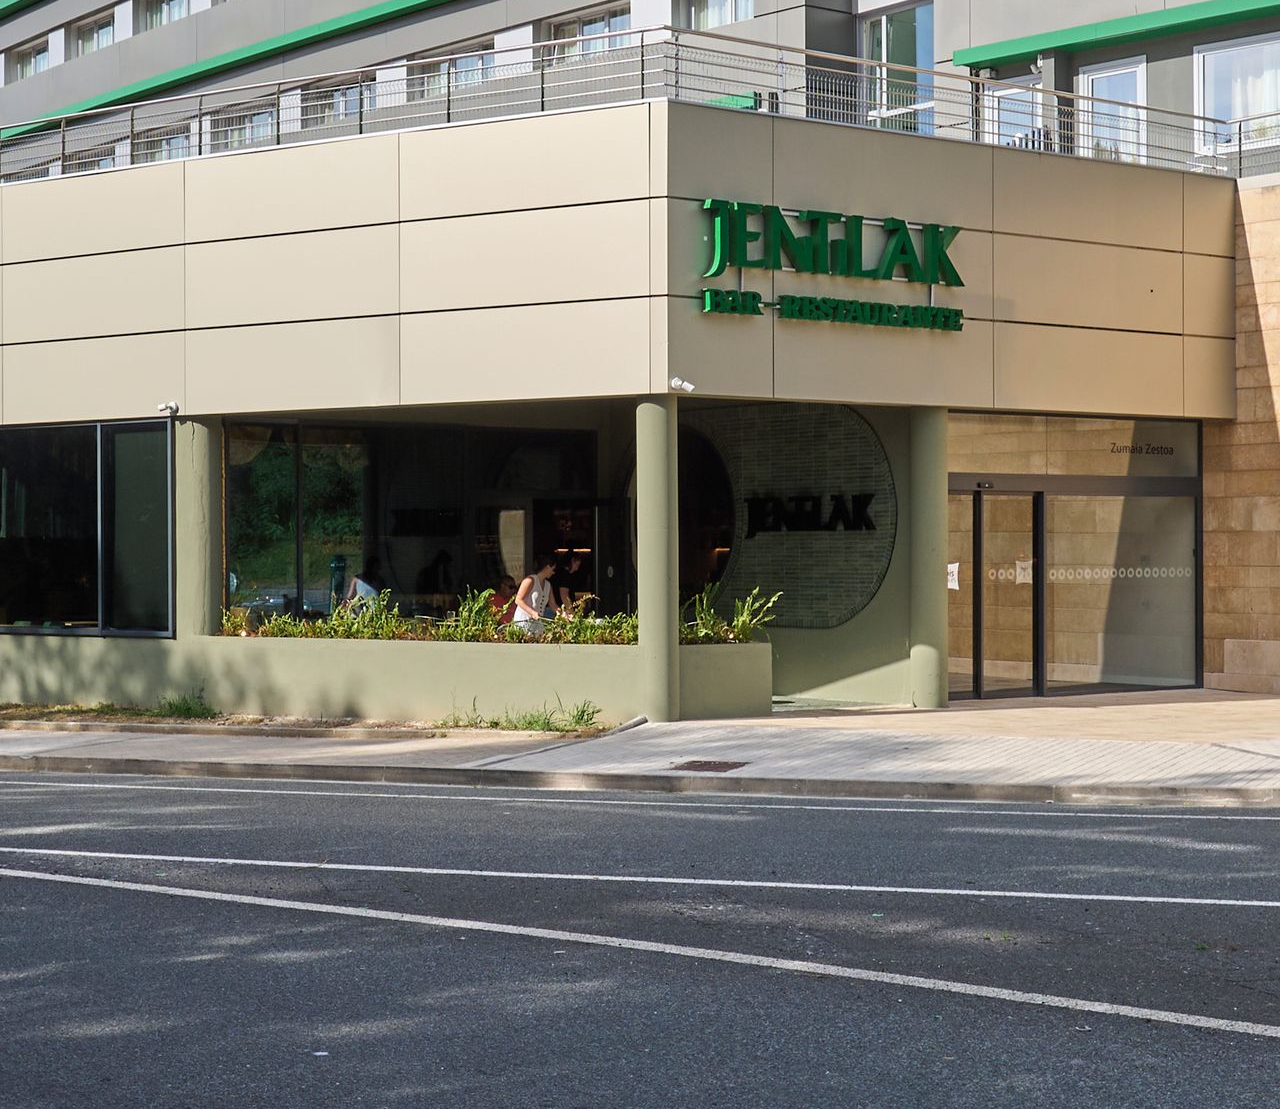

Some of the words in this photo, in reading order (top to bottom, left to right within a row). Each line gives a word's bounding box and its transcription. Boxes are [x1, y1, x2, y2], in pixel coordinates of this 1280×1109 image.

[702, 288, 764, 316] BAR
[777, 294, 964, 332] RESTAURANTE
[1110, 442, 1143, 454] Zumaia
[1145, 443, 1174, 456] Zestoa
